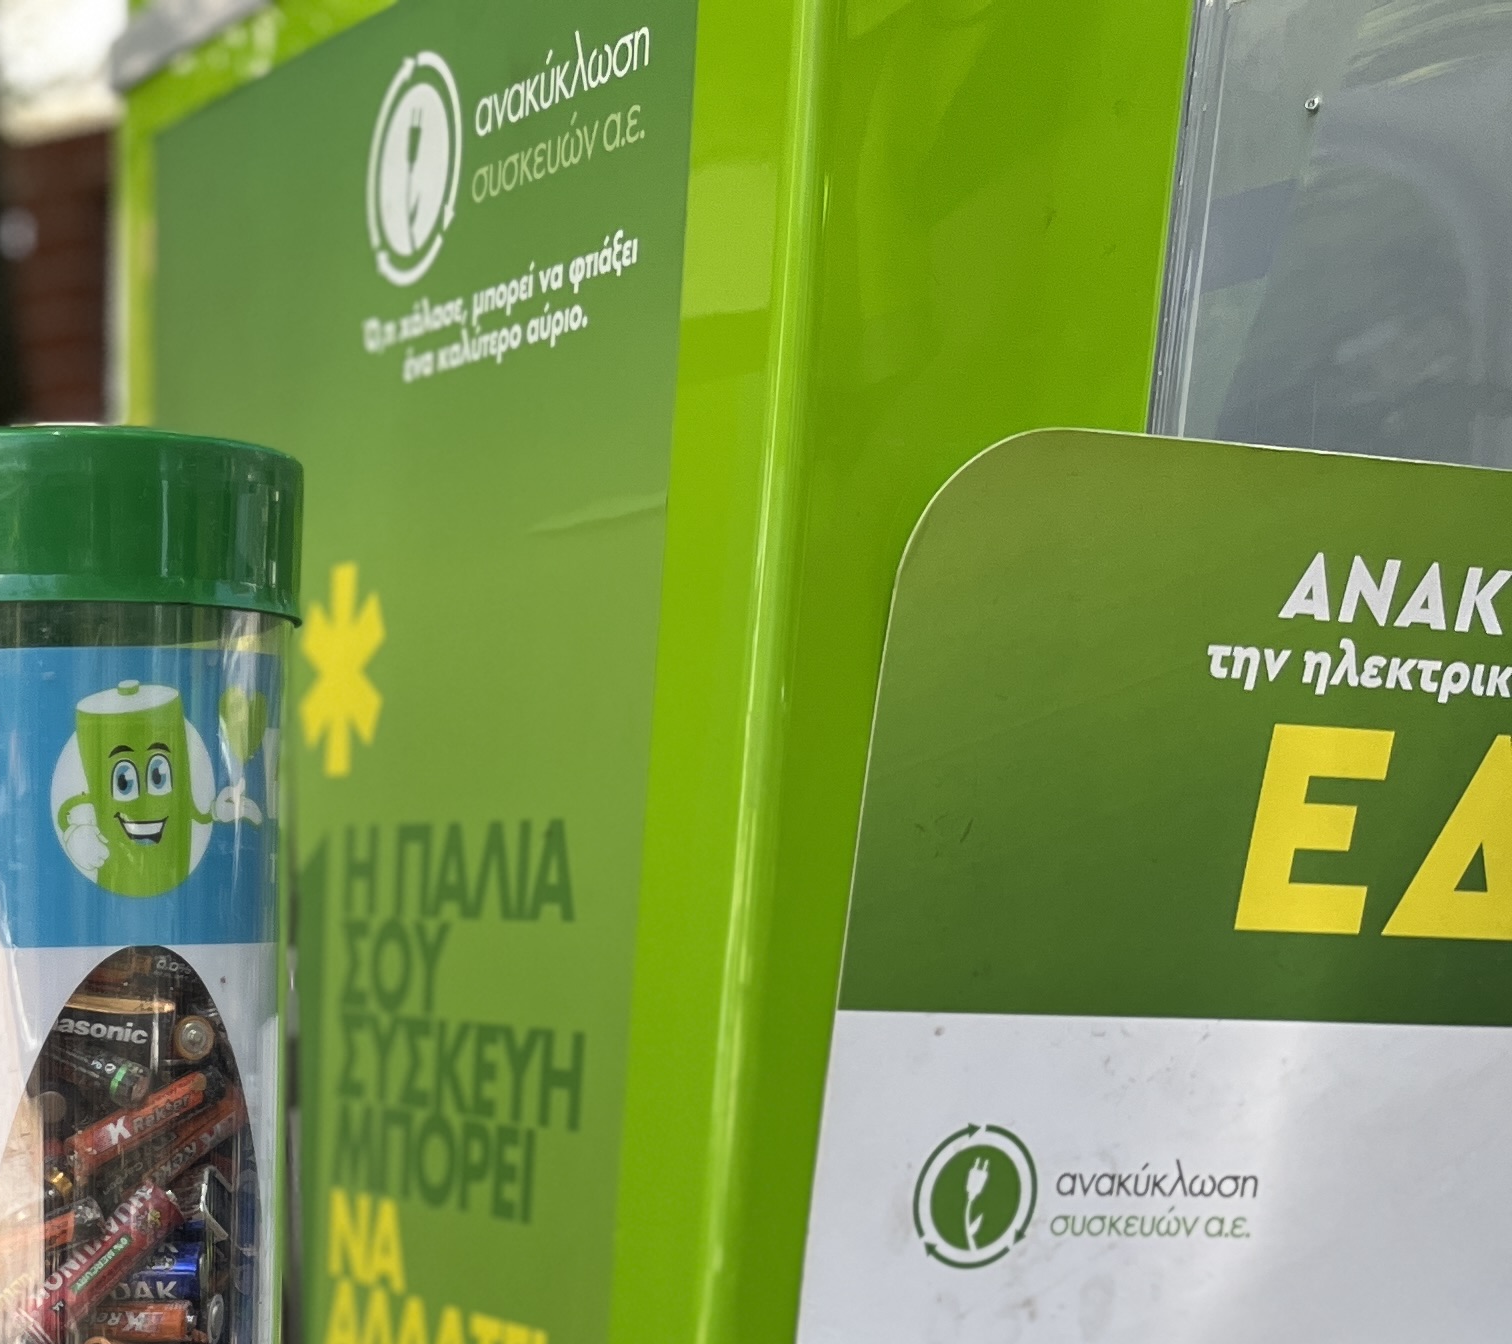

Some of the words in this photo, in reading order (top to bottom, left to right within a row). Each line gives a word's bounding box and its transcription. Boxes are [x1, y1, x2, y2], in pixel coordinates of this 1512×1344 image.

[475, 26, 651, 137] ανακύκλωση
[472, 111, 599, 203] συσκευών
[603, 105, 646, 152] α.ε.
[472, 261, 534, 326] μπορεί
[539, 266, 563, 293] να
[569, 229, 638, 294] φτιάξει
[437, 324, 522, 365] καλύτερο
[526, 302, 588, 348] αύριο.
[1279, 552, 1512, 637] ΑΝΑΚ
[1206, 643, 1291, 691] την
[344, 823, 380, 916] Η
[396, 818, 577, 922] ΠΑΛΙΑ
[342, 918, 450, 1014] ΣΟΥ
[51, 1018, 148, 1044] asonic
[336, 1012, 585, 1134] ΣΥΣΚΕΥΗ
[332, 1104, 537, 1226] ΜΠΟΡΕΙ
[1055, 1159, 1259, 1200] ανακύκλωση
[328, 1187, 406, 1296] ΝΑ
[1049, 1206, 1198, 1239] συσκευών
[1205, 1215, 1252, 1239] α.ε.
